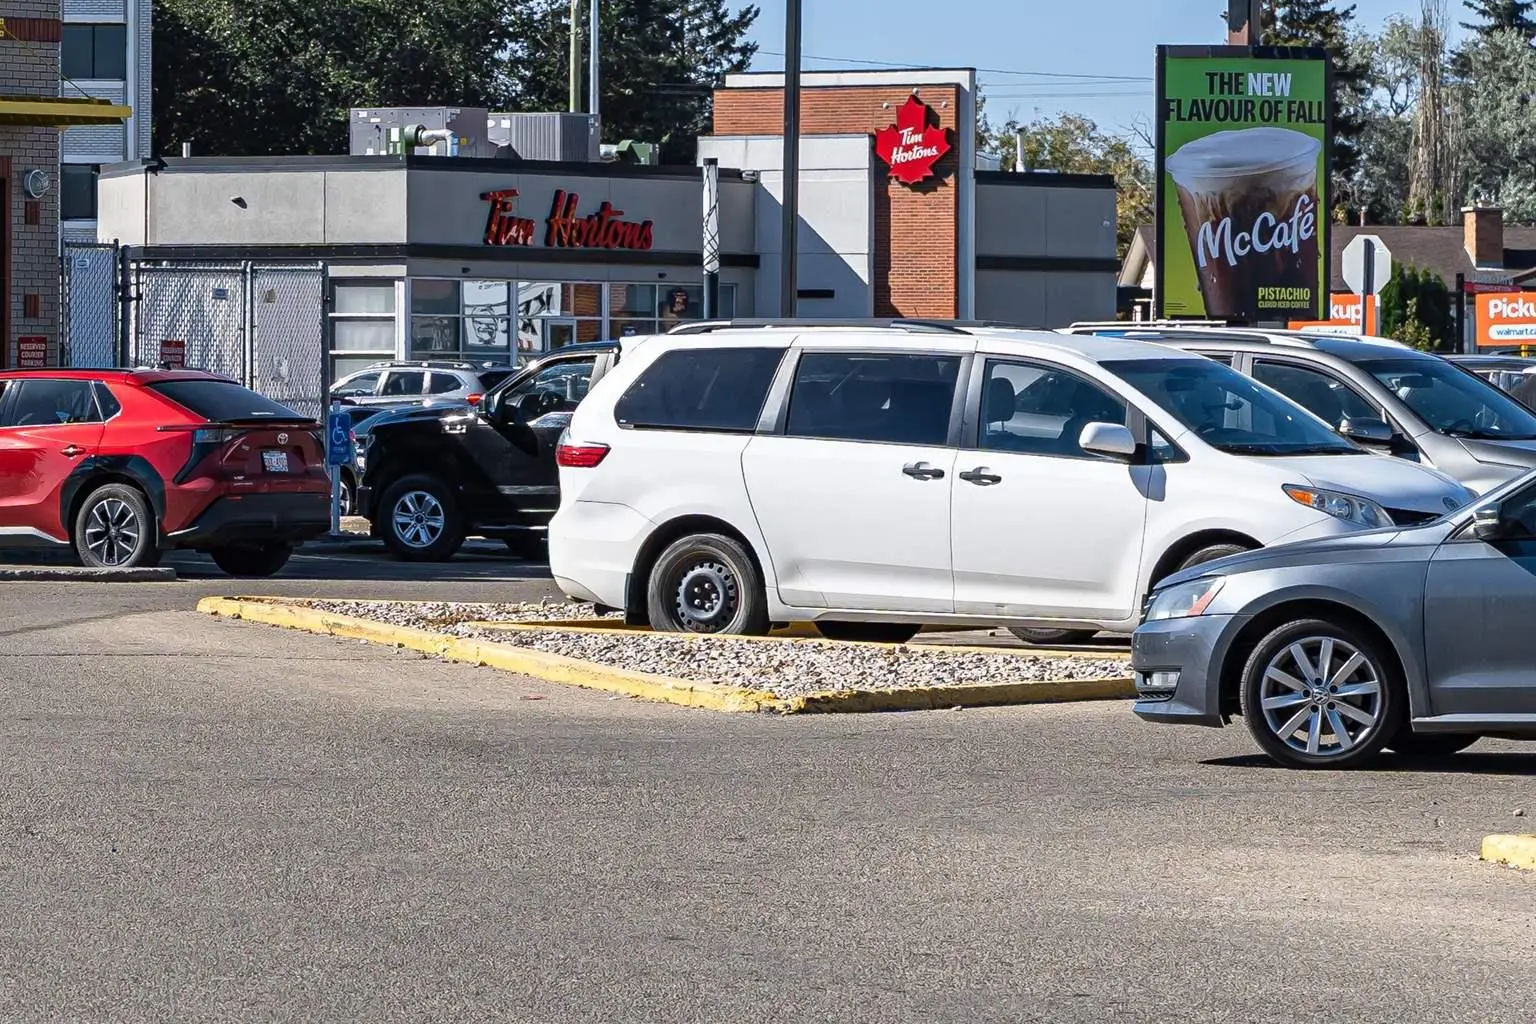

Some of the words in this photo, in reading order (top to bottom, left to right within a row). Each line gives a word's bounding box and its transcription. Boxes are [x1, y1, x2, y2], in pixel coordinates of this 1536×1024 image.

[1205, 72, 1244, 96] THE
[1248, 72, 1292, 97] NEW
[1165, 98, 1257, 123] FLAVOUR
[1259, 100, 1284, 123] OF
[1286, 100, 1326, 124] FALL
[899, 126, 923, 146] Tim
[891, 145, 939, 165] Hortons
[479, 188, 536, 246] Tim
[545, 189, 654, 250] Hortons
[1197, 193, 1315, 268] McCafé
[1258, 287, 1311, 301] PISTACHIO
[19, 343, 46, 351] RESERVED
